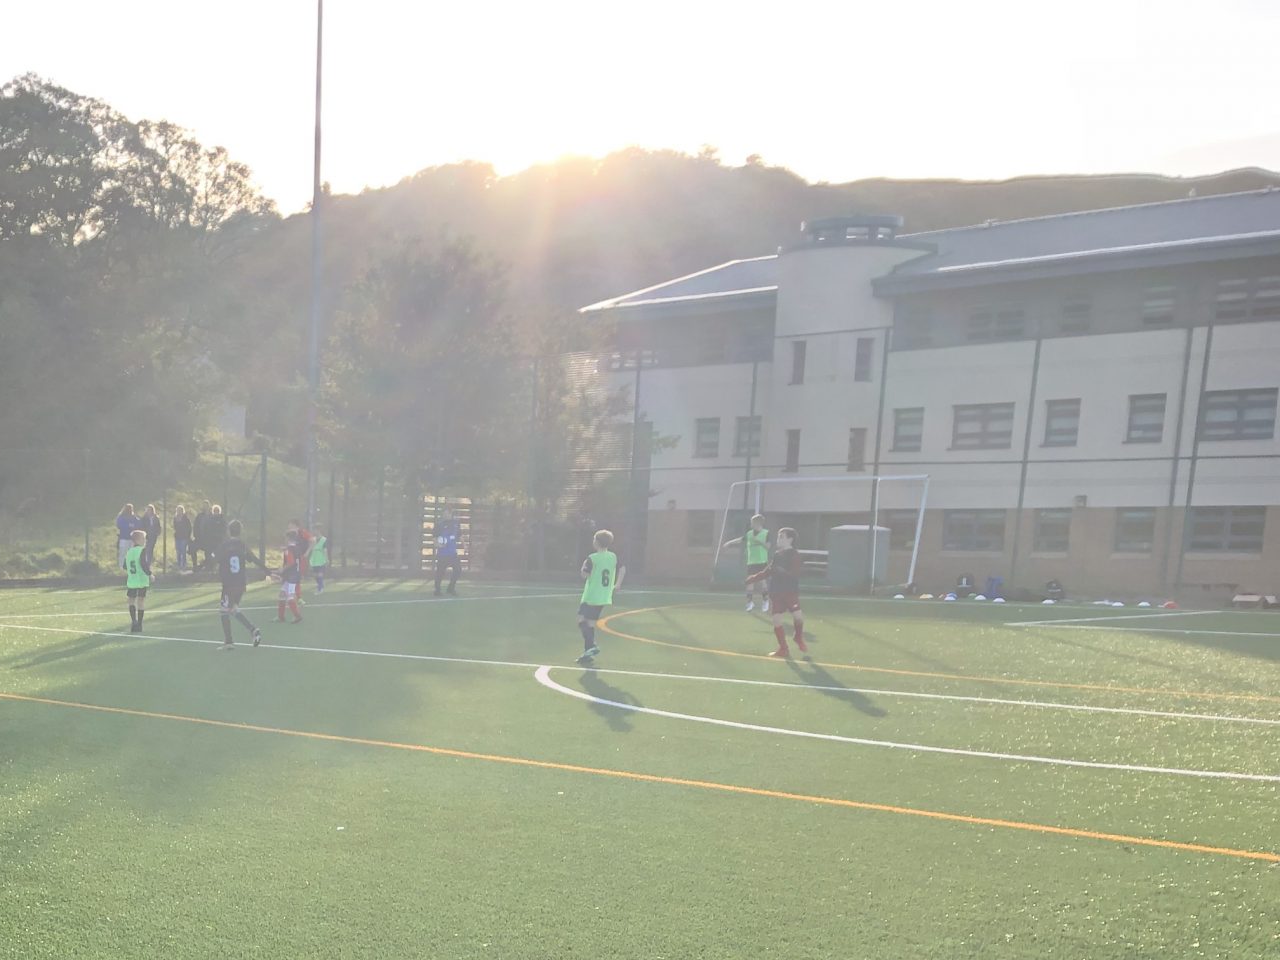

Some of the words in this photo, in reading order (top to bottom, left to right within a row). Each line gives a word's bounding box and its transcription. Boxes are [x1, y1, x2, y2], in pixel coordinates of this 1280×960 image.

[129, 560, 137, 575] 5
[230, 555, 240, 573] 9
[601, 568, 610, 588] 6
